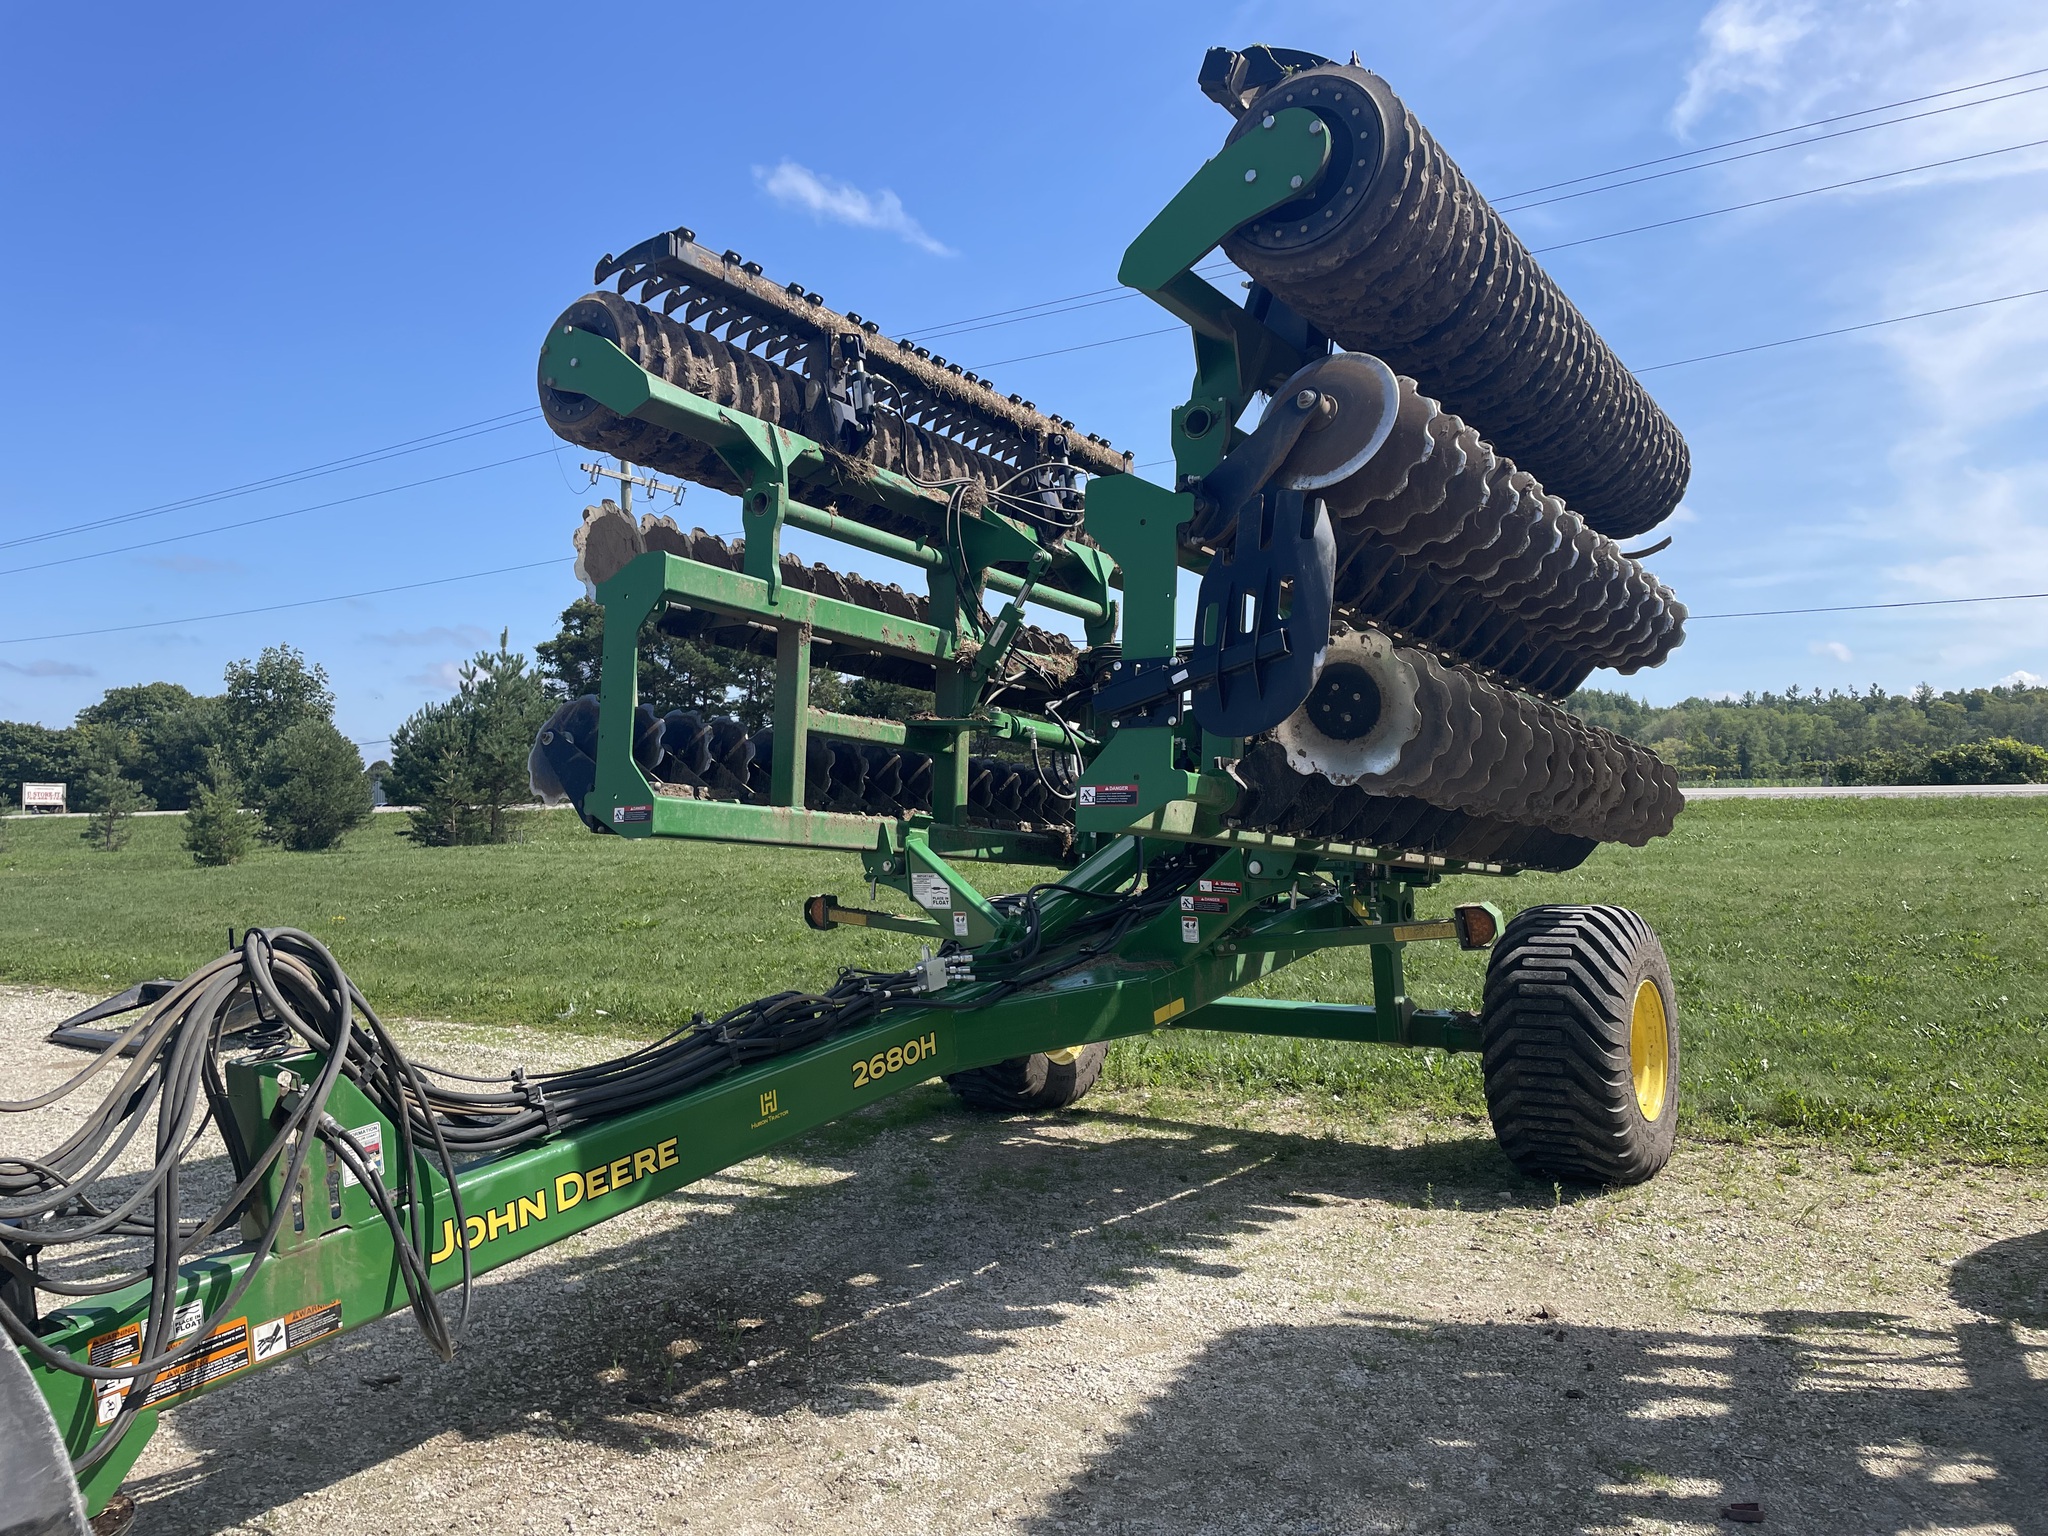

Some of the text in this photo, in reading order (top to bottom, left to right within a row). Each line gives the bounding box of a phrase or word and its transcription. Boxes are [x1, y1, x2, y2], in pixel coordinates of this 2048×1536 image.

[852, 1031, 937, 1090] 2680H
[768, 1109, 789, 1122] TRACTOR
[430, 1136, 680, 1264] JOHN DEERE
[175, 1316, 194, 1327] PLACE
[175, 1319, 202, 1334] FLOAT
[99, 1325, 137, 1344] WARNING
[172, 1356, 209, 1375] WARNING
